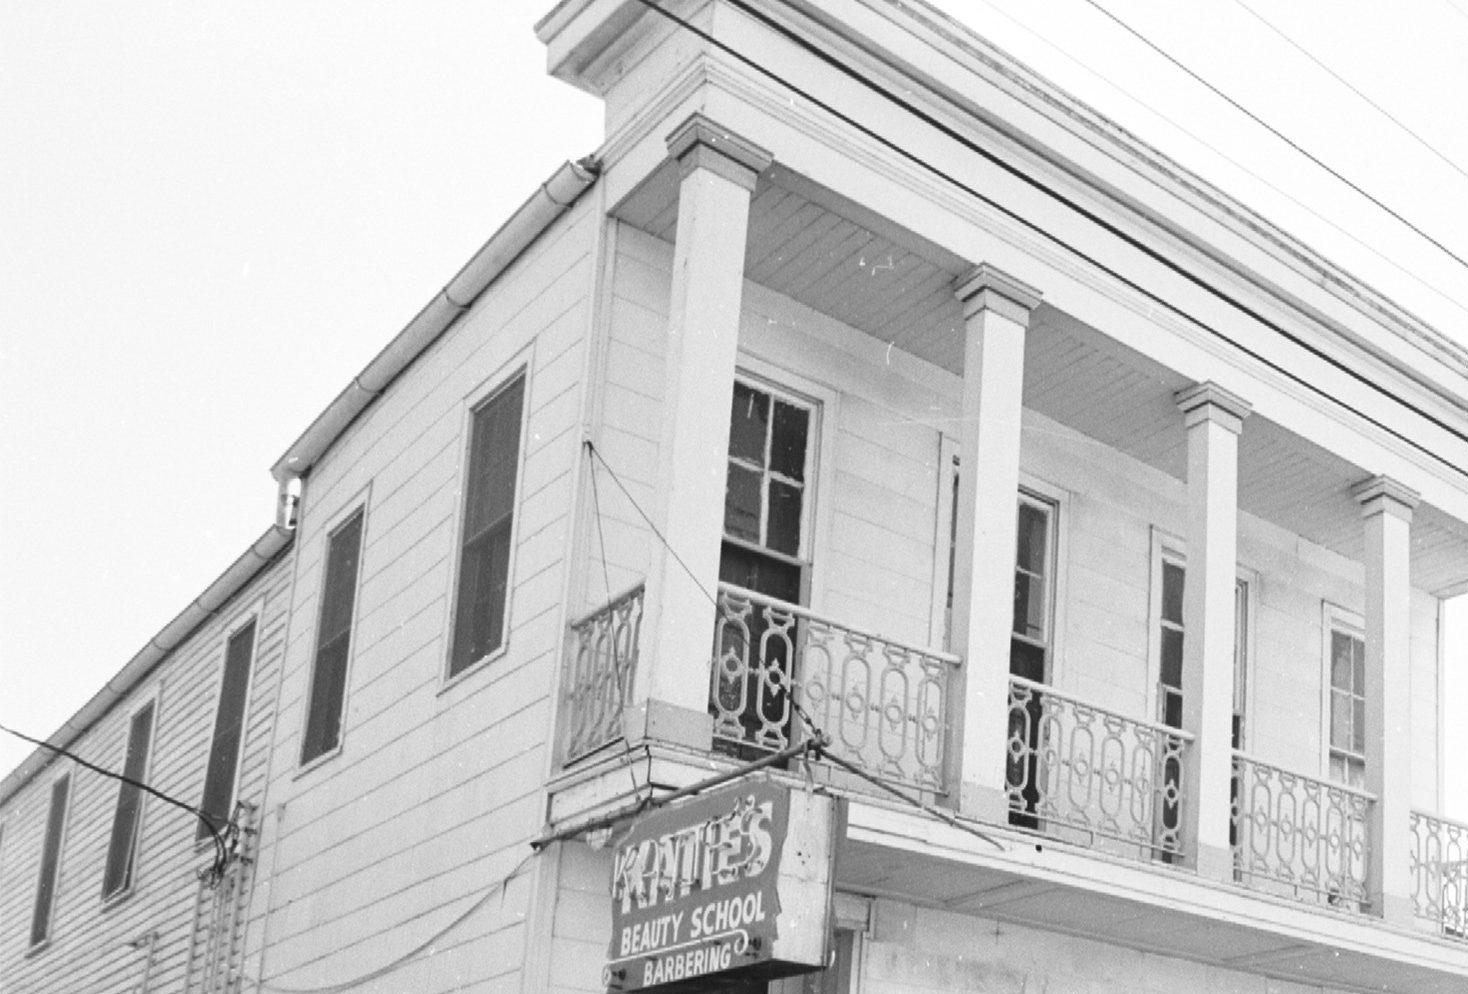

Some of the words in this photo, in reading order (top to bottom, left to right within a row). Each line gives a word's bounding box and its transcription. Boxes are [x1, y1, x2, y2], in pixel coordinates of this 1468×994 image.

[612, 794, 773, 914] KATIE'S
[620, 911, 684, 956] BEAUTY
[690, 891, 766, 938] SCHOOL
[642, 943, 732, 986] BARBERING
